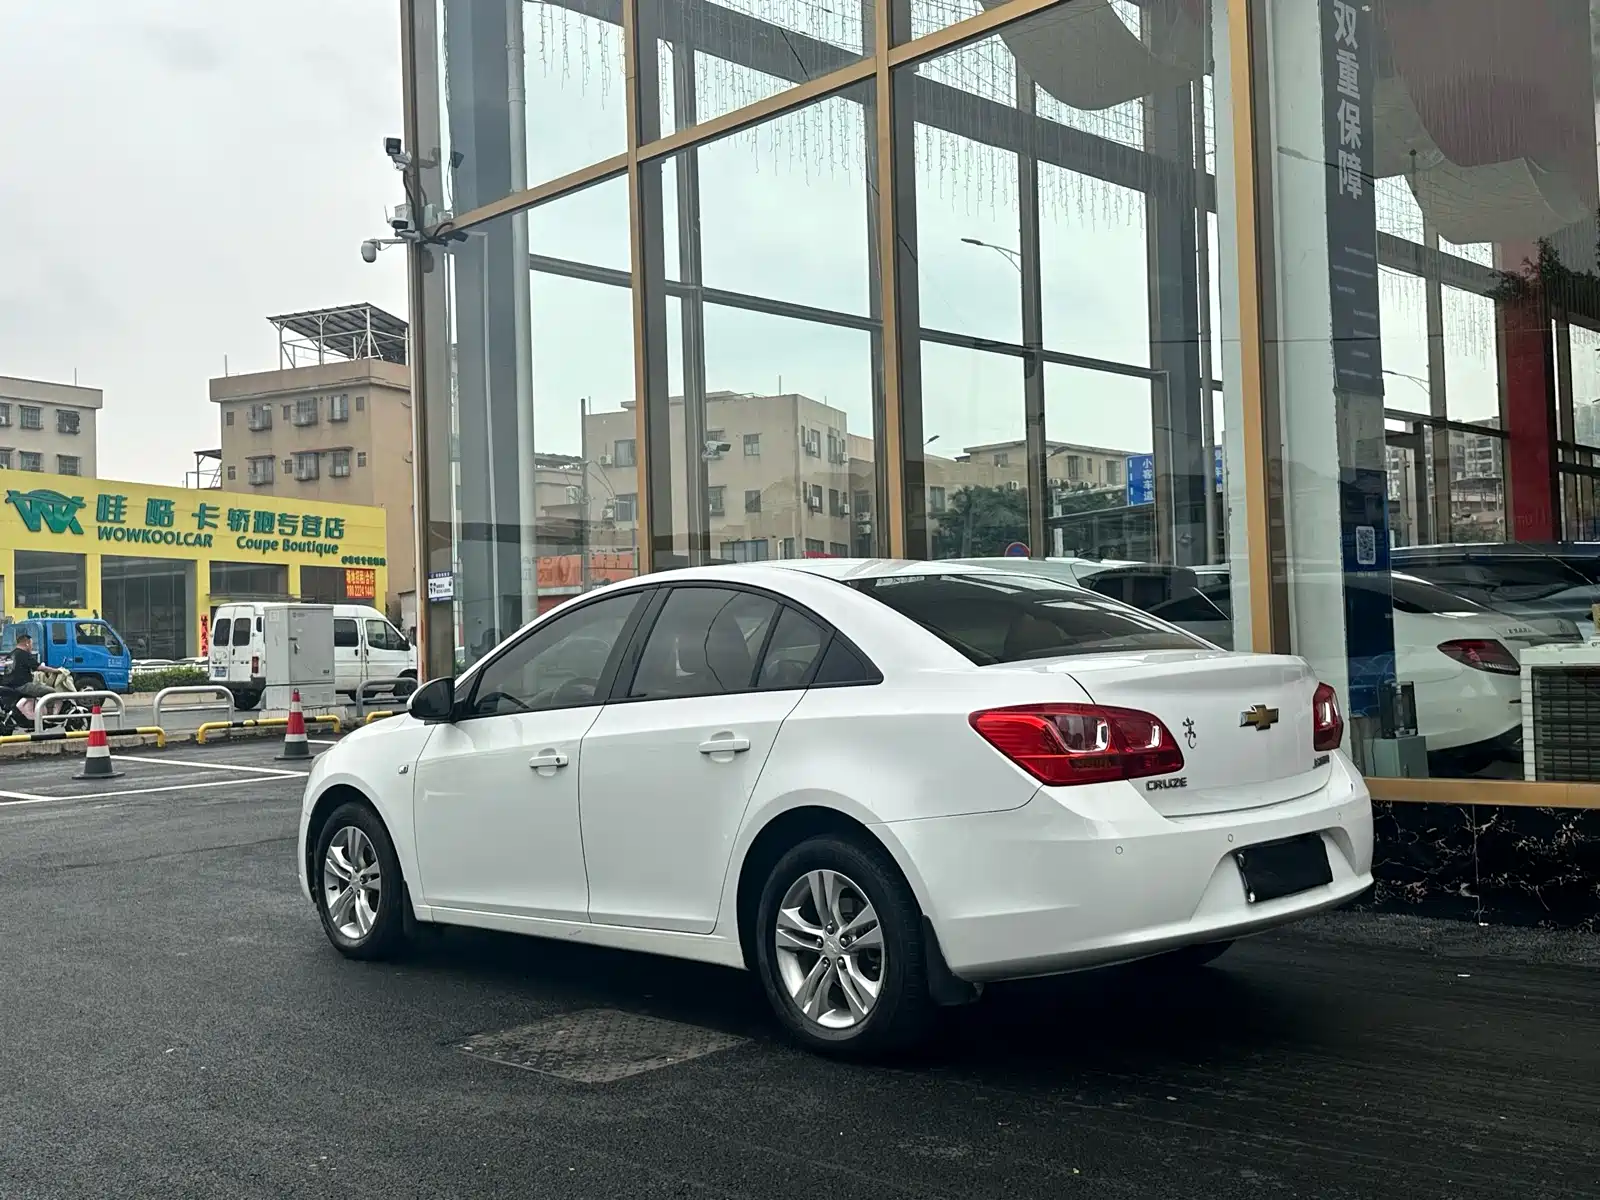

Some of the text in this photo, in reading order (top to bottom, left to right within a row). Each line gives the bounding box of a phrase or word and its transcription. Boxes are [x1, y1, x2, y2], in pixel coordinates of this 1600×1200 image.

[1333, 0, 1362, 200] 双重保障
[1142, 458, 1154, 501] 小客车道
[97, 525, 339, 558] WOWKOOLCAR Coupe Boutique
[1145, 777, 1188, 792] CRUZE
